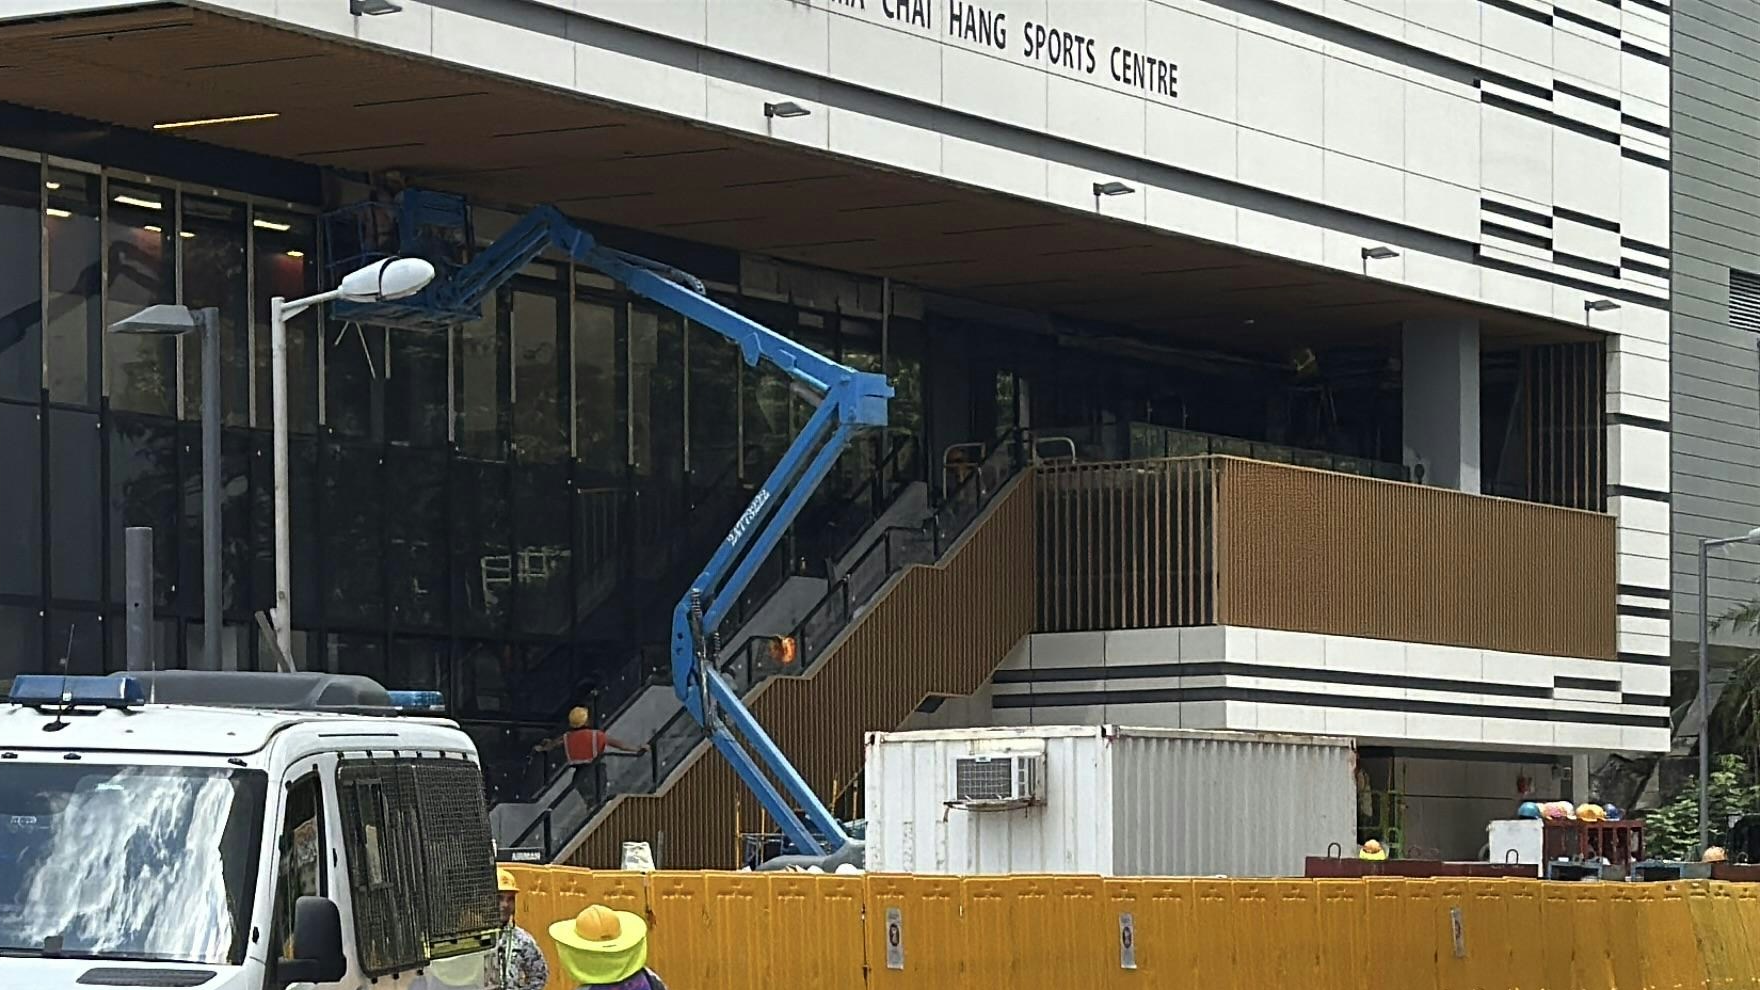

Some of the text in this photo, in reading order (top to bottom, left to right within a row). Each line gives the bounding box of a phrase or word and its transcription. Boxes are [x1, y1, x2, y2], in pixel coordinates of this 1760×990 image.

[949, 0, 1007, 49] HANG
[1023, 21, 1096, 74] SPORTS
[1110, 46, 1178, 98] CENTRE
